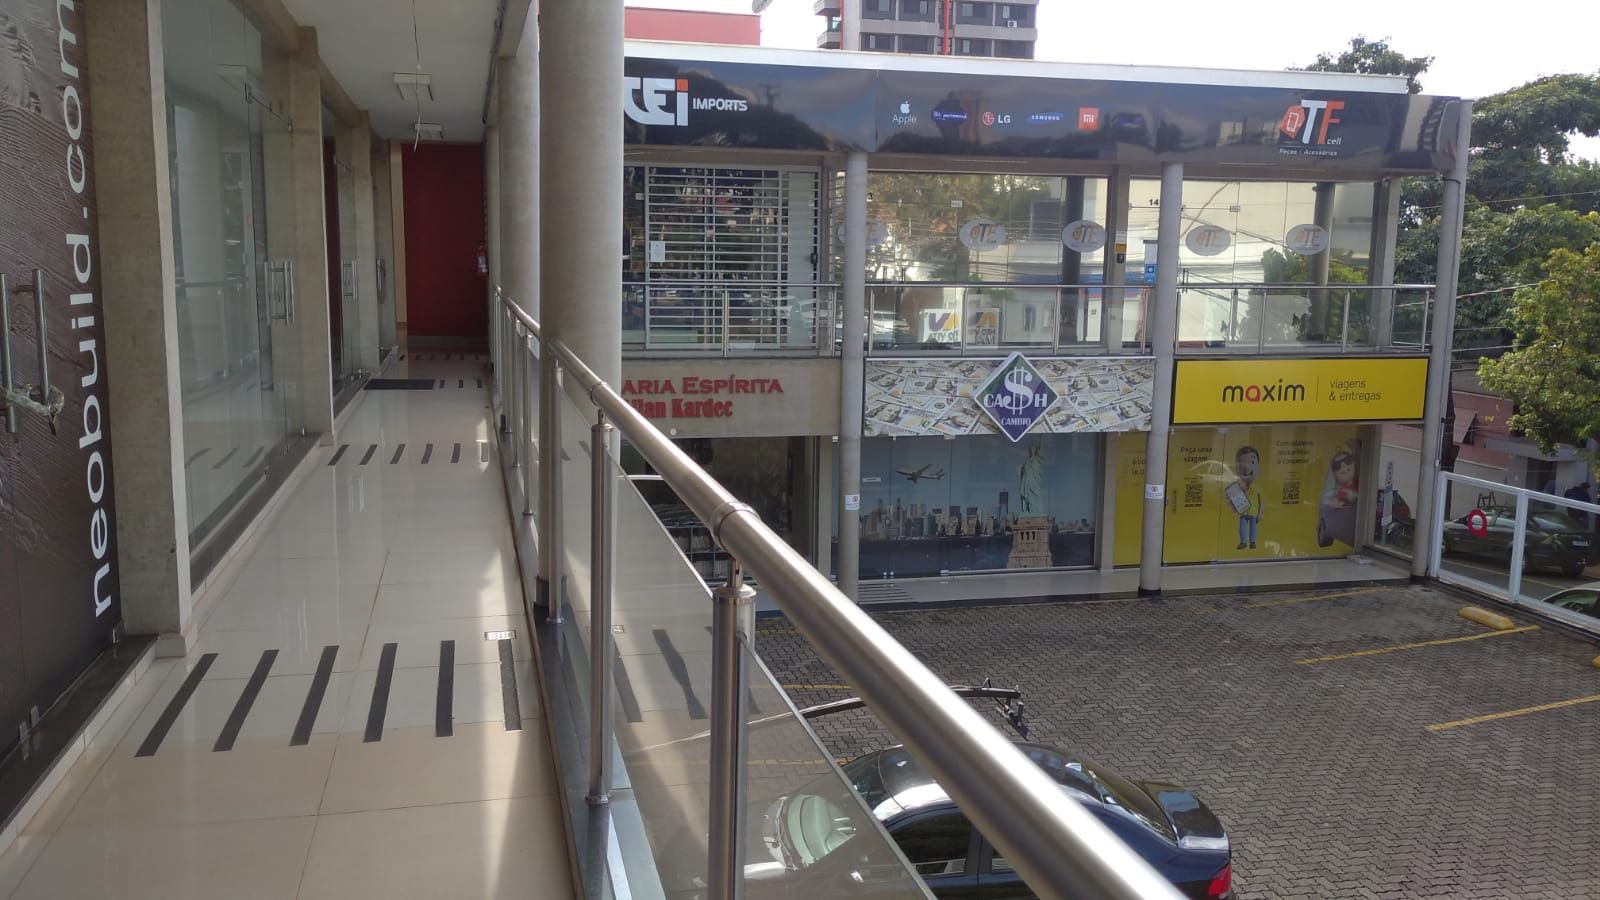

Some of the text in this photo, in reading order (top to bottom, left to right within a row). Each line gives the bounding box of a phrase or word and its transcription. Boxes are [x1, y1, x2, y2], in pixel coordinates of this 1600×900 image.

[692, 98, 748, 112] IMPORTS
[892, 113, 917, 126] Apple
[997, 114, 1011, 124] LG
[1222, 379, 1305, 403] maxim
[1329, 379, 1366, 390] viagens
[1329, 391, 1382, 403] & entregas
[624, 398, 733, 418] llan Kardec
